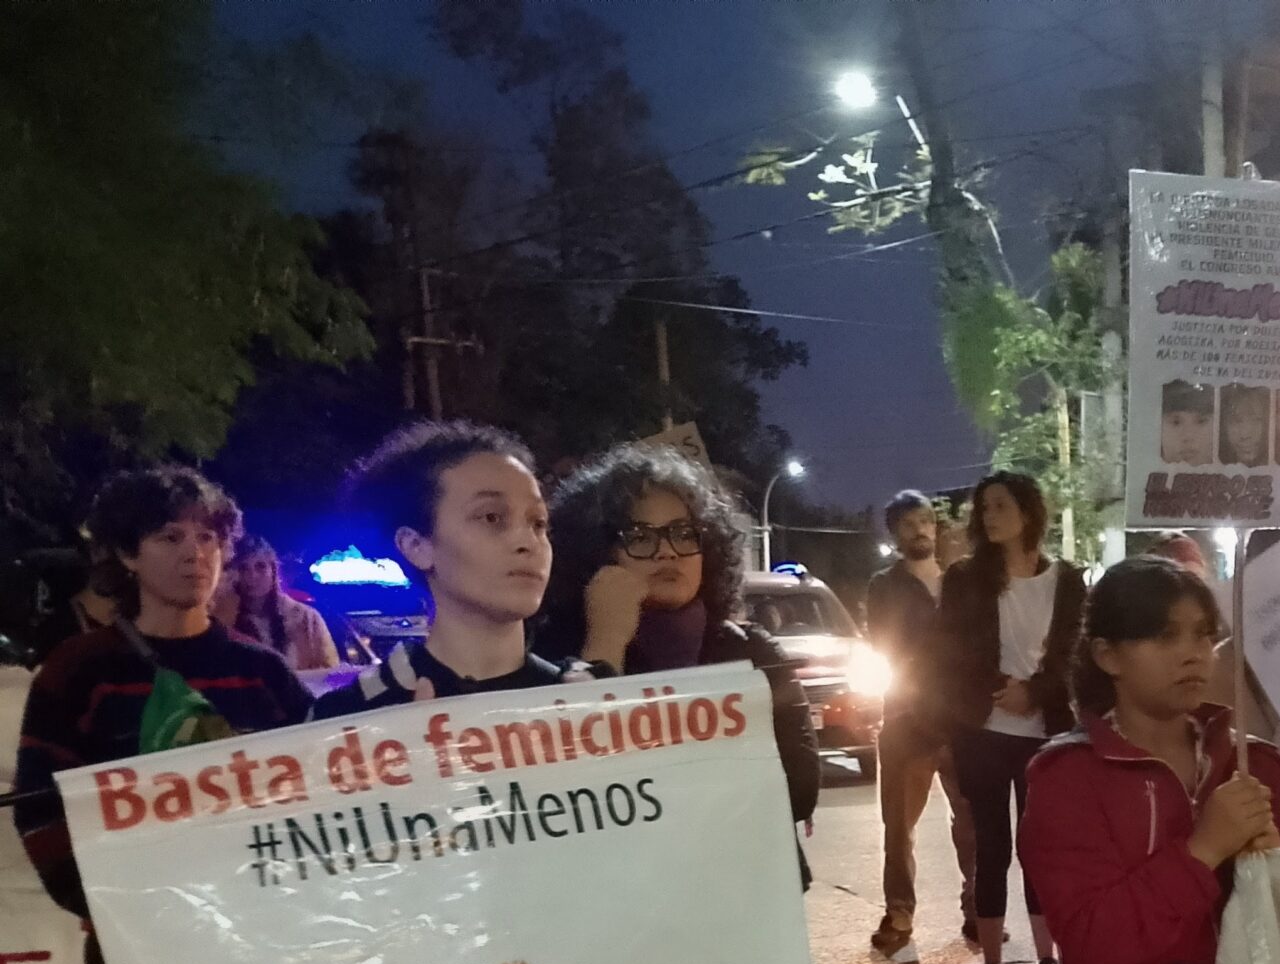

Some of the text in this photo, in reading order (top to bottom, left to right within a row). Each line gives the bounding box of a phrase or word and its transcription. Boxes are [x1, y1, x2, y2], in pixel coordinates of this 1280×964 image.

[1170, 233, 1243, 249] PRESIDENTE
[1180, 259, 1195, 271] EL
[1200, 261, 1262, 275] CONGRESO
[93, 686, 748, 831] Basta de femicidios
[248, 777, 663, 888] #NiUnaMenos
